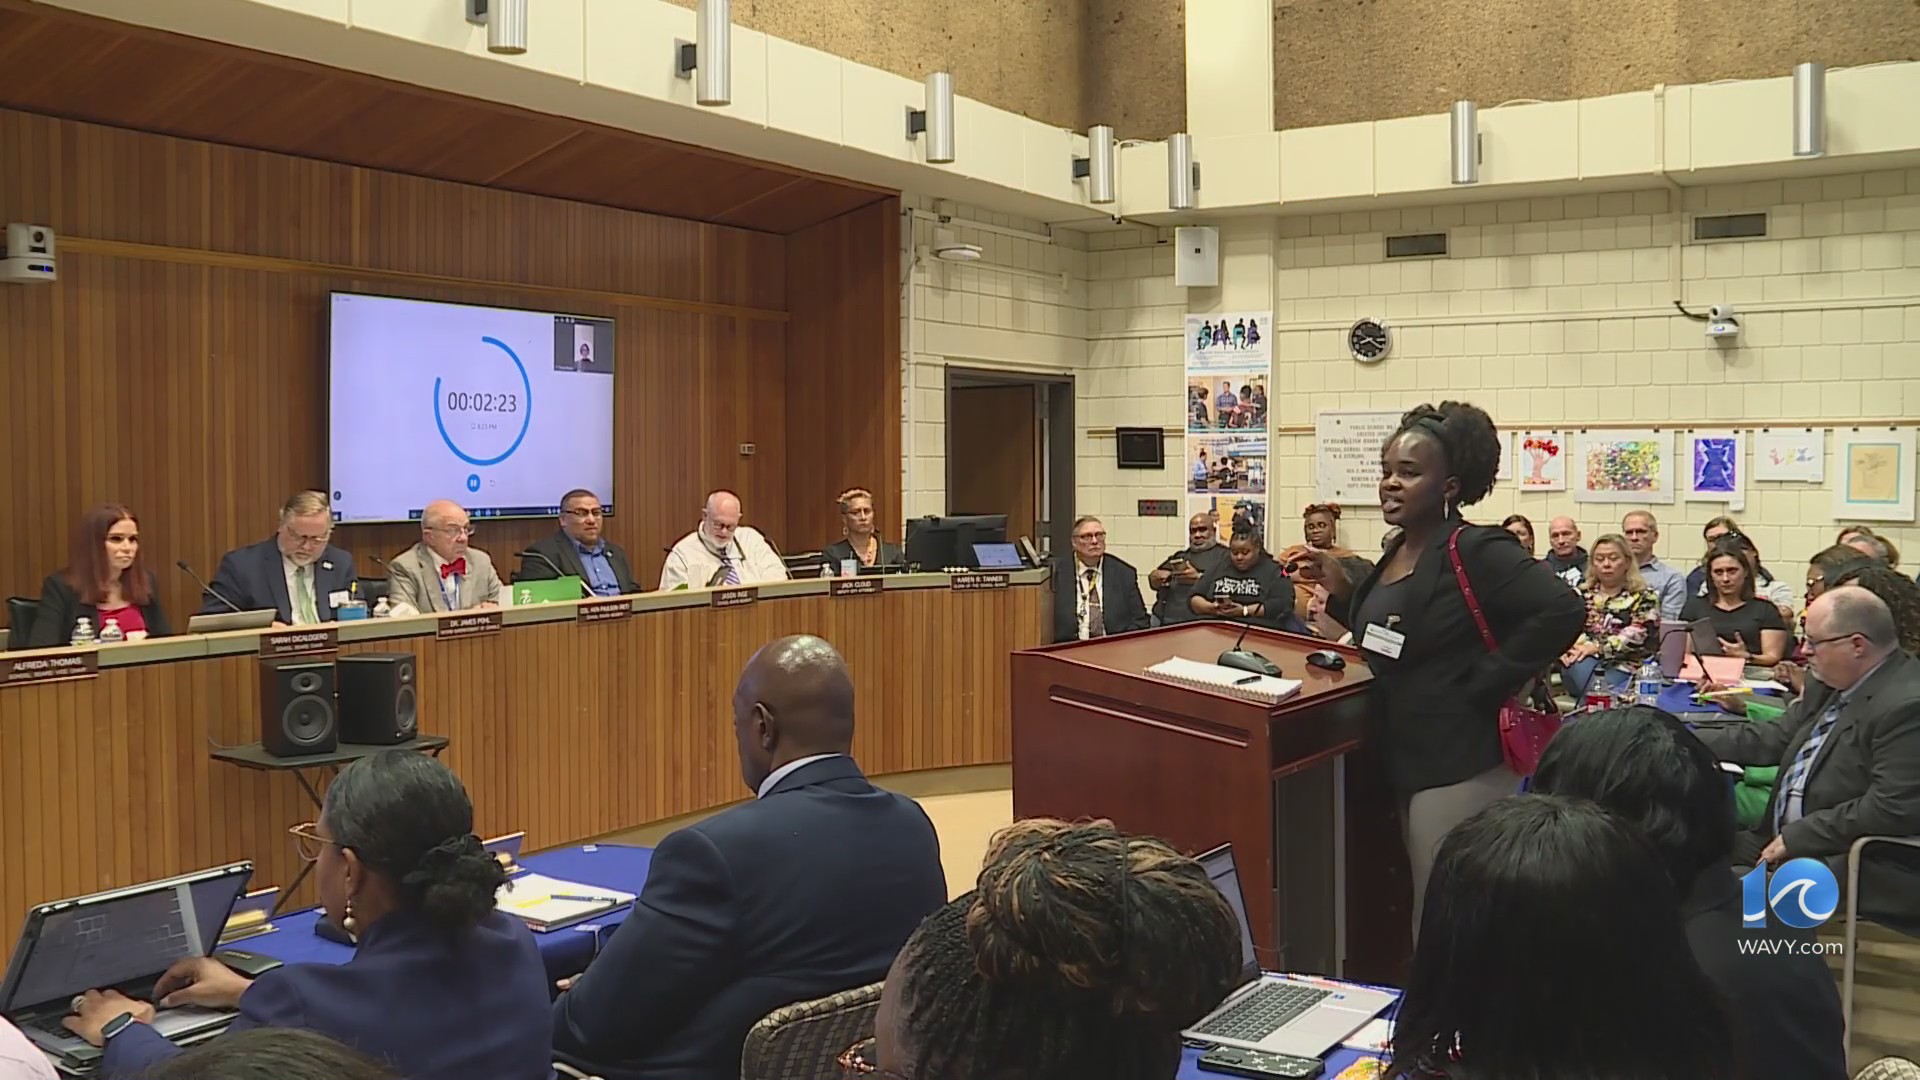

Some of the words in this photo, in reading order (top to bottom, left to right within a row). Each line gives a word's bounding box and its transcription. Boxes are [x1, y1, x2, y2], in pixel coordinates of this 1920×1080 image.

[448, 392, 516, 412] 00:02:23
[1214, 584, 1259, 595] LOVERS
[722, 592, 737, 600] JASON
[600, 604, 618, 612] PAULSON
[460, 618, 477, 626] JAMES
[477, 616, 491, 624] POHL
[270, 636, 291, 645] SARAH
[292, 633, 328, 643] DICALOGERO
[13, 660, 48, 671] ALFREDA
[50, 657, 82, 667] THOMAS
